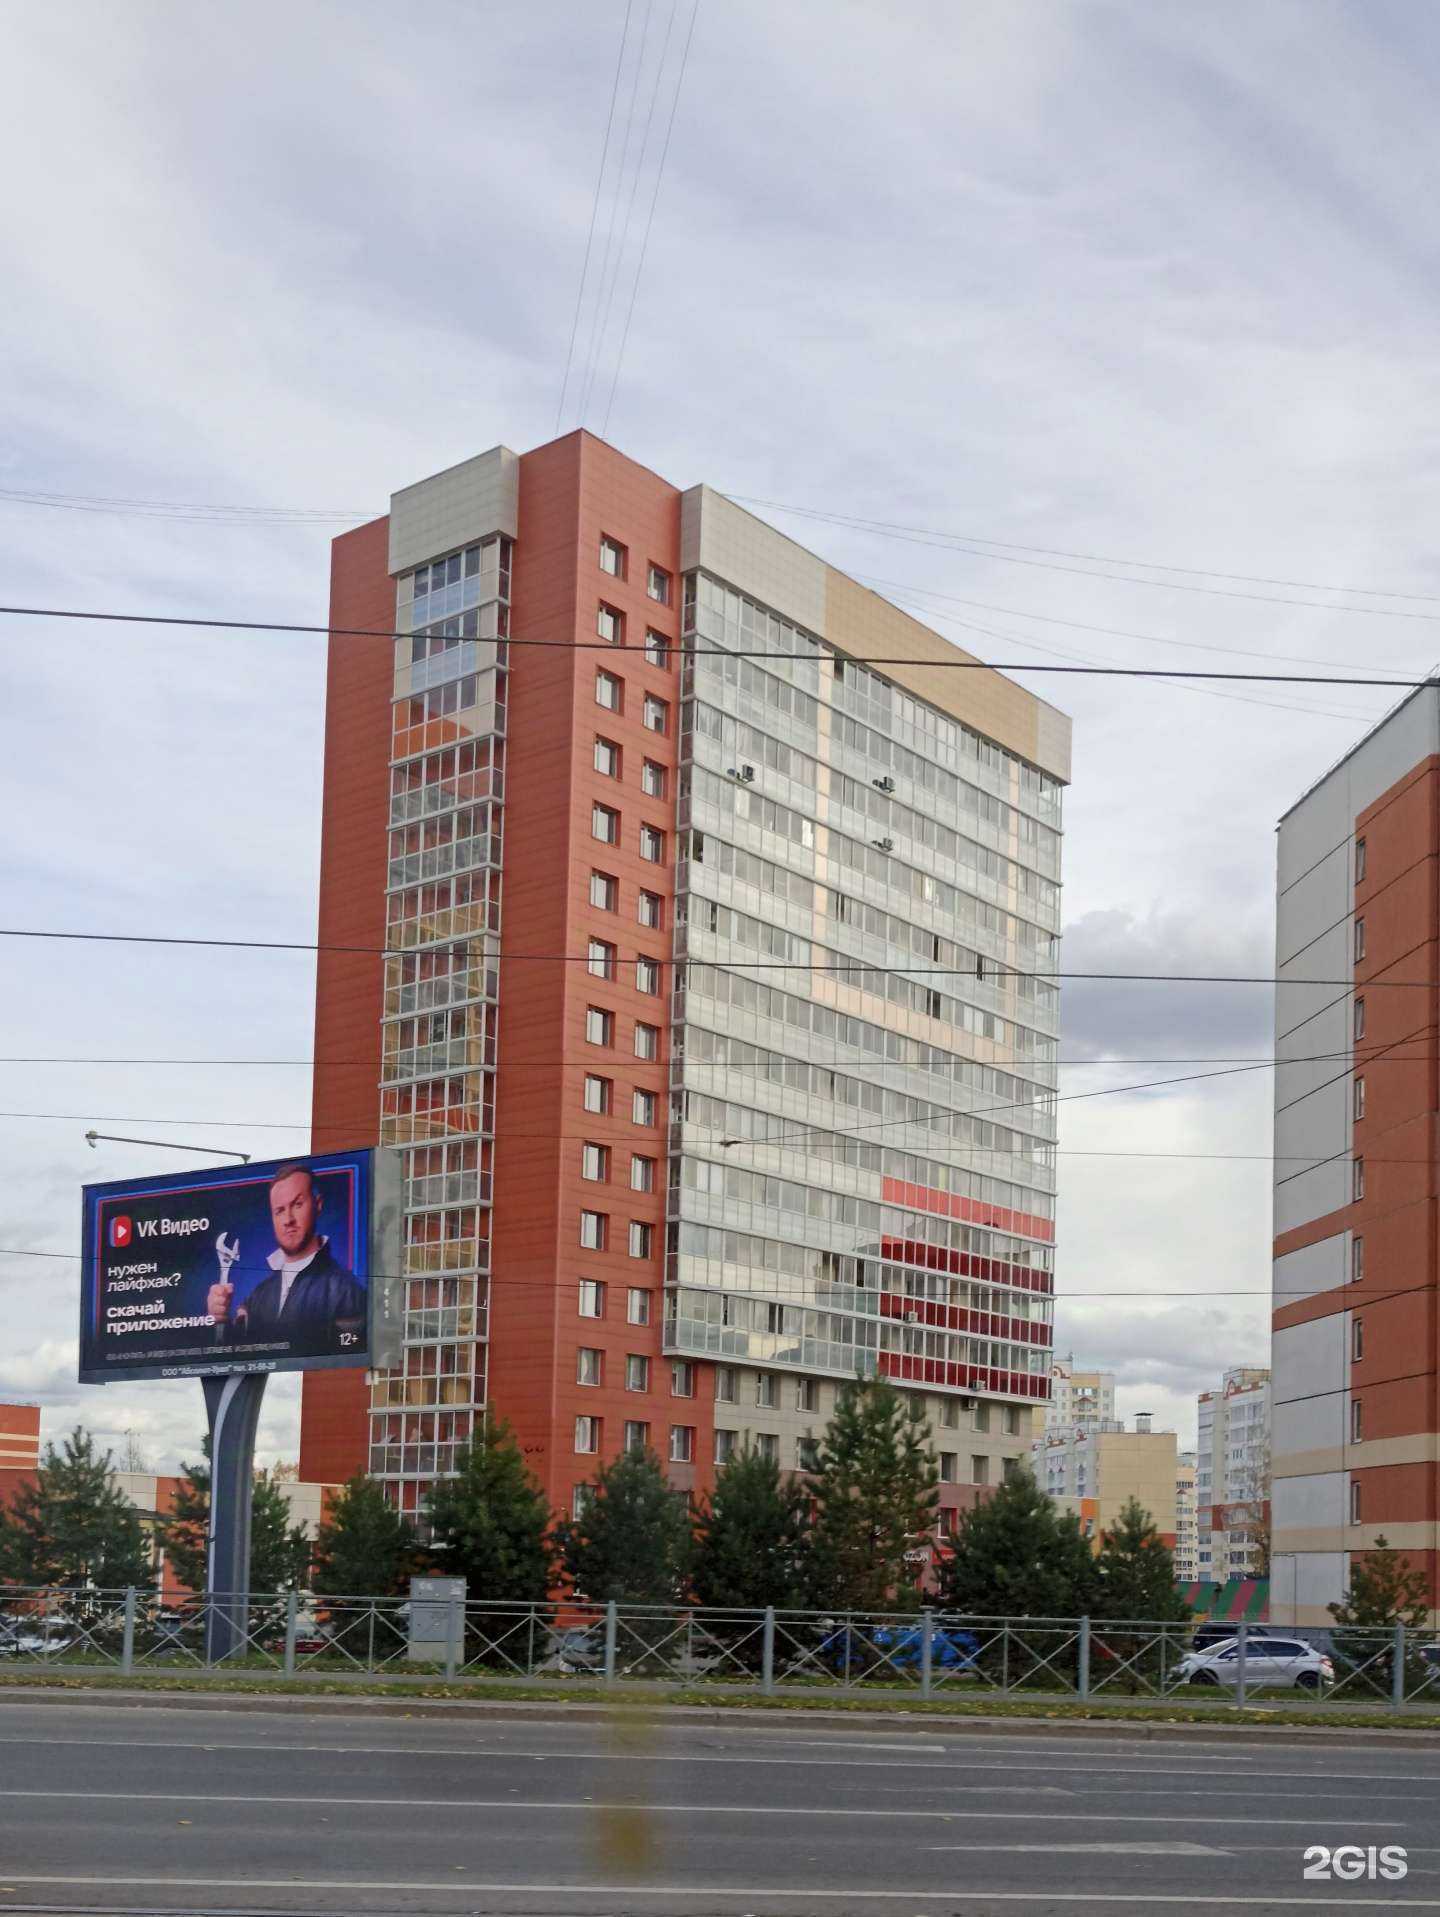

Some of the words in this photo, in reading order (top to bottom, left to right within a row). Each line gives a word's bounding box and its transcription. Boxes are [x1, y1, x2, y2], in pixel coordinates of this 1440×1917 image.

[137, 1220, 158, 1238] VK
[160, 1218, 210, 1236] Видео
[107, 1262, 158, 1279] нужен
[107, 1272, 181, 1292] лайфхак?
[106, 1299, 166, 1318] скачай
[106, 1315, 216, 1336] приложение
[339, 1332, 359, 1346] 12+
